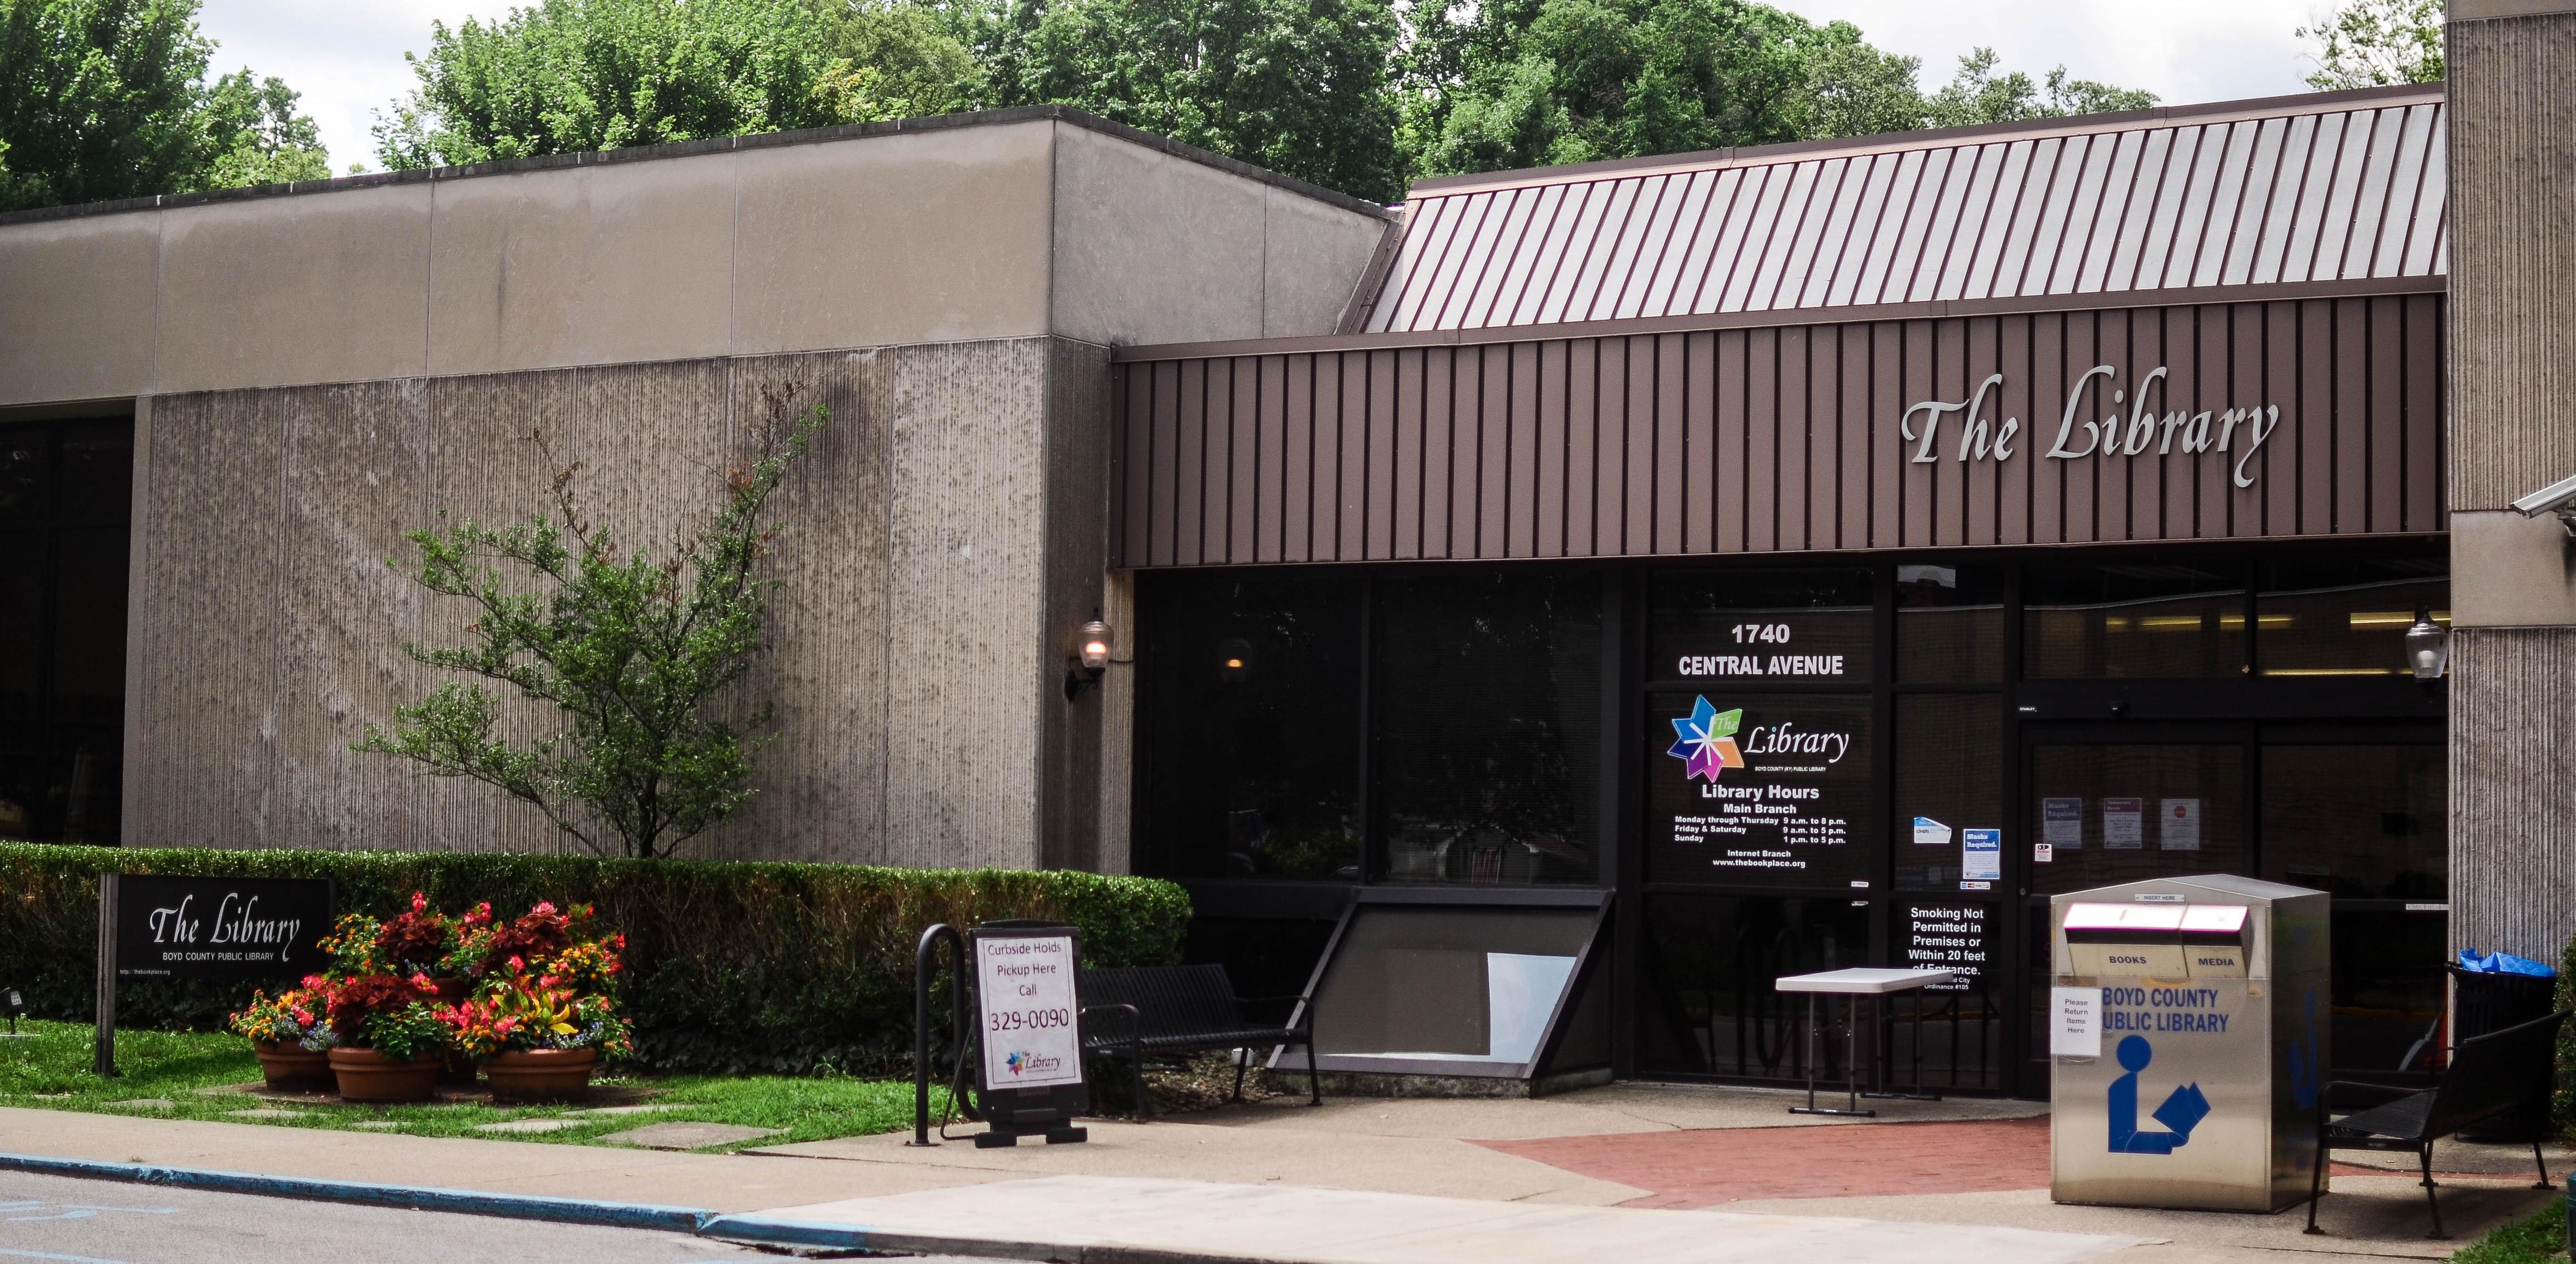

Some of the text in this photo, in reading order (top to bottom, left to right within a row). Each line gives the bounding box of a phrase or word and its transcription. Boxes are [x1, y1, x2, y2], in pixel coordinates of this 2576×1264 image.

[1902, 364, 2279, 488] The Library
[1733, 624, 1790, 643] 1740
[1679, 656, 1843, 675] CENTRAL AVENUE
[1715, 715, 1849, 763] The Library
[1703, 784, 1819, 801] Library Hours
[1724, 804, 1796, 813] Main Branch
[1741, 817, 1779, 825] Thursday
[1675, 825, 1699, 834] Friday
[1711, 825, 1746, 834] Saturday
[1675, 834, 1703, 842] Sunday
[1713, 859, 1805, 868] www.thebookplace.org
[1911, 908, 1983, 920] Smoking Not
[150, 893, 300, 962] The Library
[1914, 922, 1981, 932] Permitted in
[1914, 936, 1965, 946] Premises
[988, 941, 1061, 955] Curbside Holds
[1909, 950, 1985, 960] Within 20 feet
[998, 964, 1056, 977] Pickup Here
[1020, 984, 1036, 996] Call
[2102, 987, 2218, 1008] BOYD COUNTY
[991, 1009, 1068, 1031] 329-0090
[2102, 1012, 2229, 1032] UBLIC LIBRARY
[1026, 1054, 1060, 1071] Library
